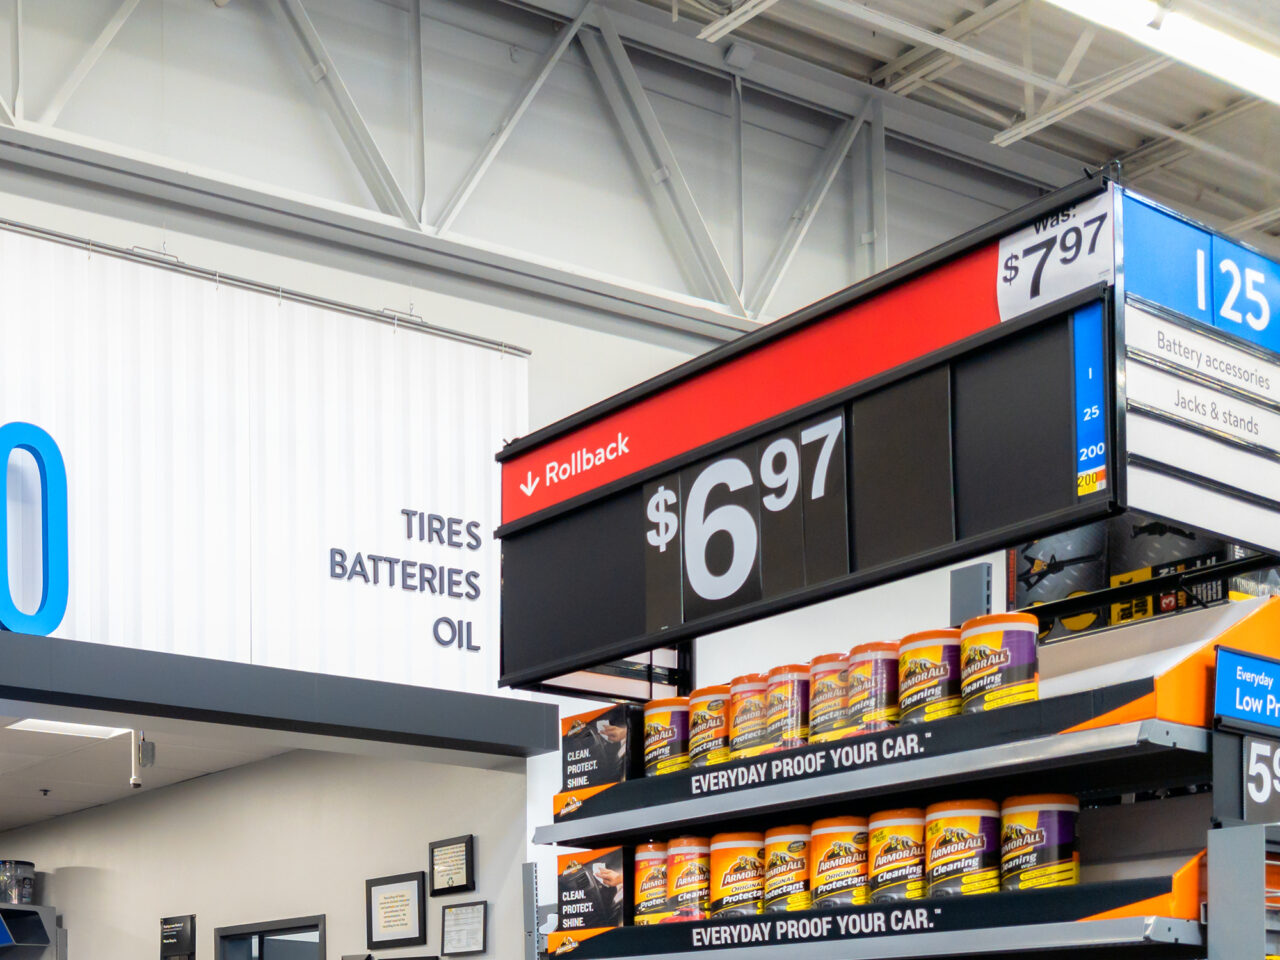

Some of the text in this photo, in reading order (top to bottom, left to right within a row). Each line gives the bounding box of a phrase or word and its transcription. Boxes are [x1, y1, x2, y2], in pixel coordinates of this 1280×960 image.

[1034, 204, 1077, 234] Was:
[1220, 258, 1270, 331] 25
[1157, 330, 1271, 390] Battery accessories
[1083, 404, 1100, 422] 25
[1173, 389, 1259, 435] Jacks & stands
[545, 432, 630, 486] Rollback
[1079, 443, 1105, 461] 200
[401, 508, 482, 550] TIRES
[330, 547, 481, 600] BATTERIES
[433, 616, 481, 651] OIL
[1236, 665, 1274, 690] Everyday
[901, 685, 942, 708] Cleaning
[1235, 687, 1263, 713] Low
[567, 749, 592, 762] CLEAN.
[567, 760, 598, 775] PROTECT.
[691, 763, 768, 794] EVERYDAY
[772, 755, 826, 780] PROOF
[830, 741, 878, 768] YOUR
[567, 776, 590, 788] SHINE.
[825, 867, 861, 881] ORIGINAL
[878, 865, 923, 883] Cleaning
[933, 858, 979, 876] Cleaning
[563, 890, 586, 901] CLEAN.
[563, 903, 594, 914] PROTECT.
[563, 917, 586, 928] SHINE.
[692, 922, 771, 946] EVERYDAY
[777, 917, 832, 939] PROOF
[837, 912, 886, 935] YOUR
